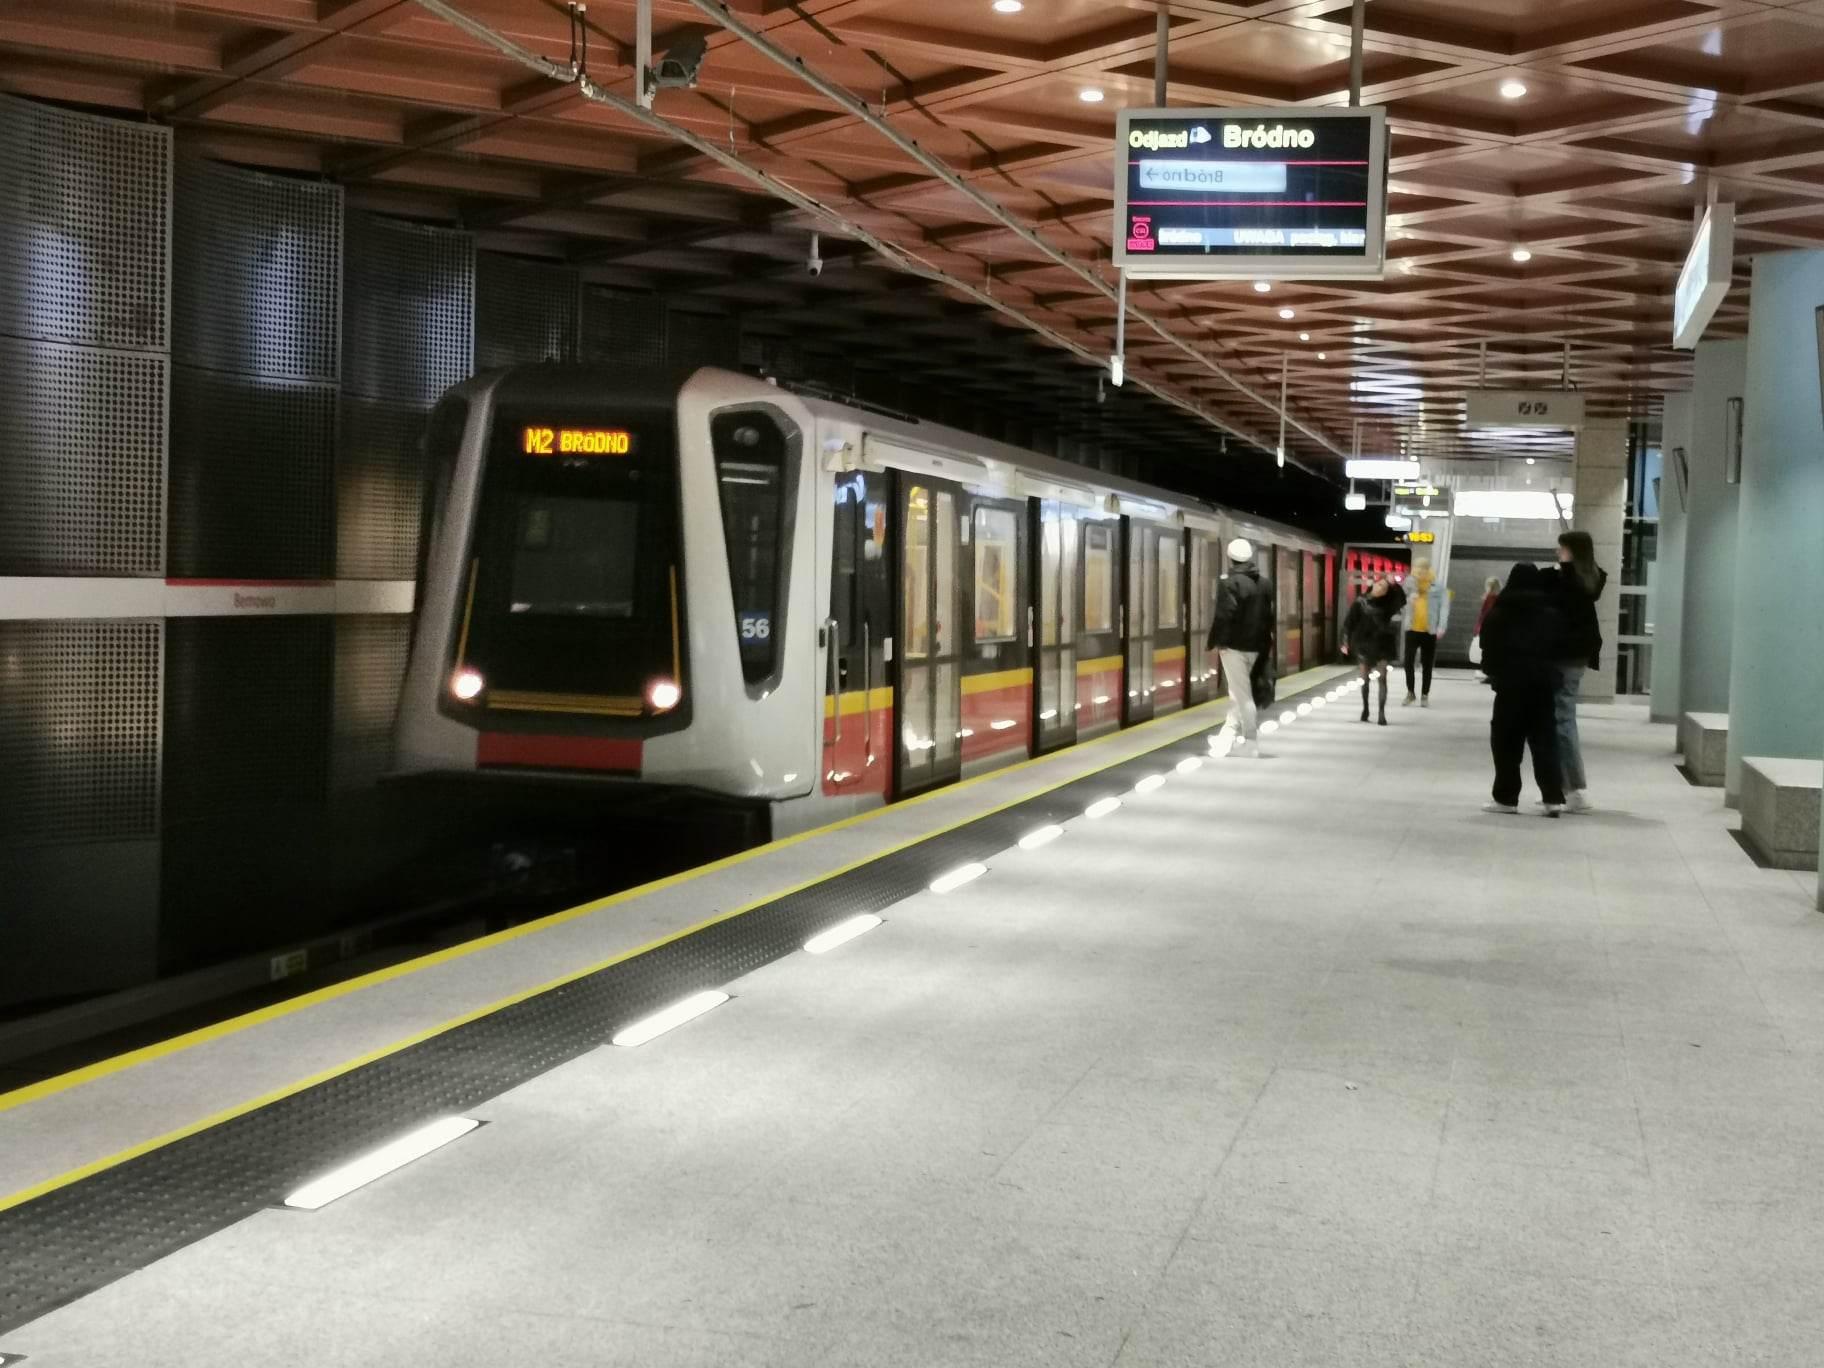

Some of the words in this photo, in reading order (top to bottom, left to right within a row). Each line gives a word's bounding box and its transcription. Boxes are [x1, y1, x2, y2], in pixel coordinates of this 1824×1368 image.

[1223, 124, 1315, 149] Bródno
[525, 427, 554, 454] M2
[742, 618, 770, 639] 56
